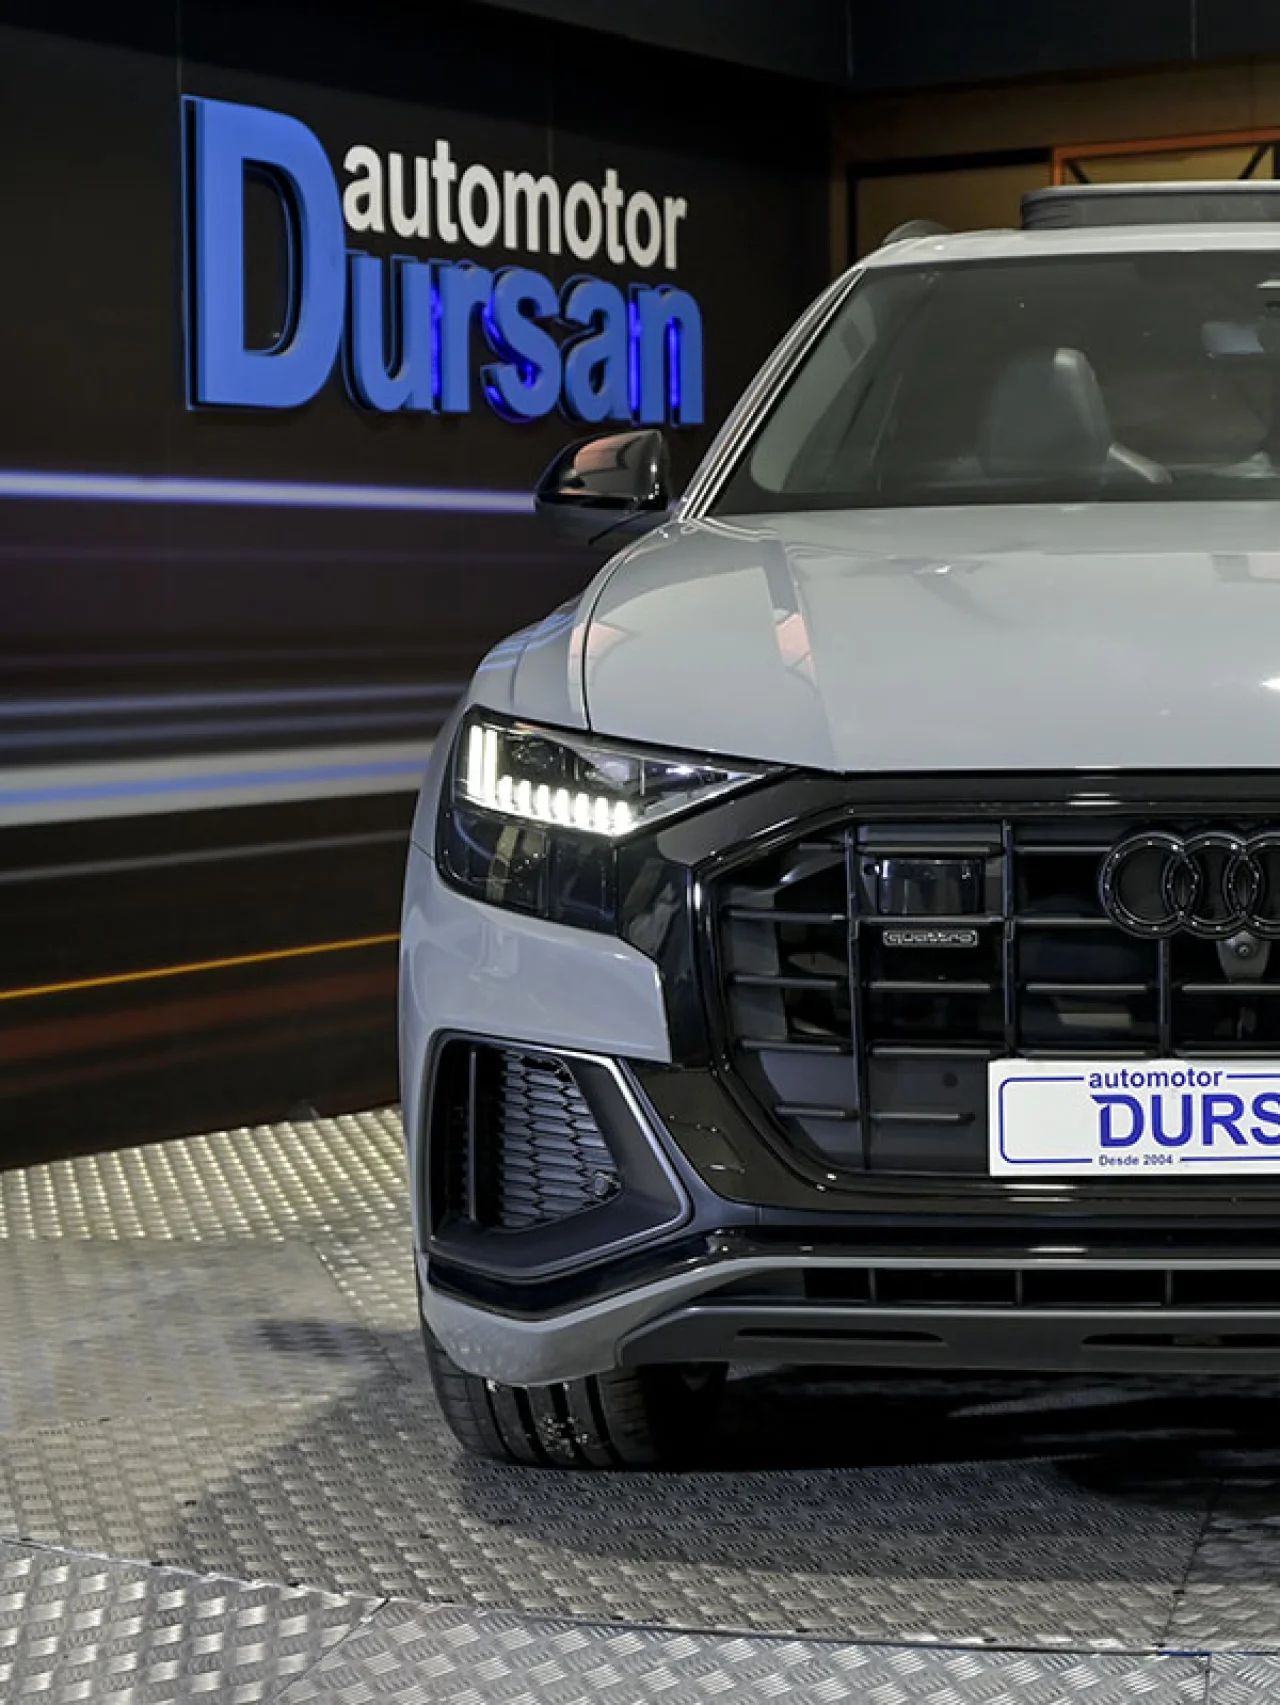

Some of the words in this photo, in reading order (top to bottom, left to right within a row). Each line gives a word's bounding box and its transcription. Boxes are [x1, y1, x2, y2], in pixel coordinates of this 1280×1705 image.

[342, 139, 687, 270] automotor
[181, 94, 704, 426] Dursan
[888, 932, 973, 944] quattro
[1089, 1069, 1223, 1088] automotor
[1099, 1154, 1139, 1166] Desde
[1143, 1154, 1173, 1165] 2004
